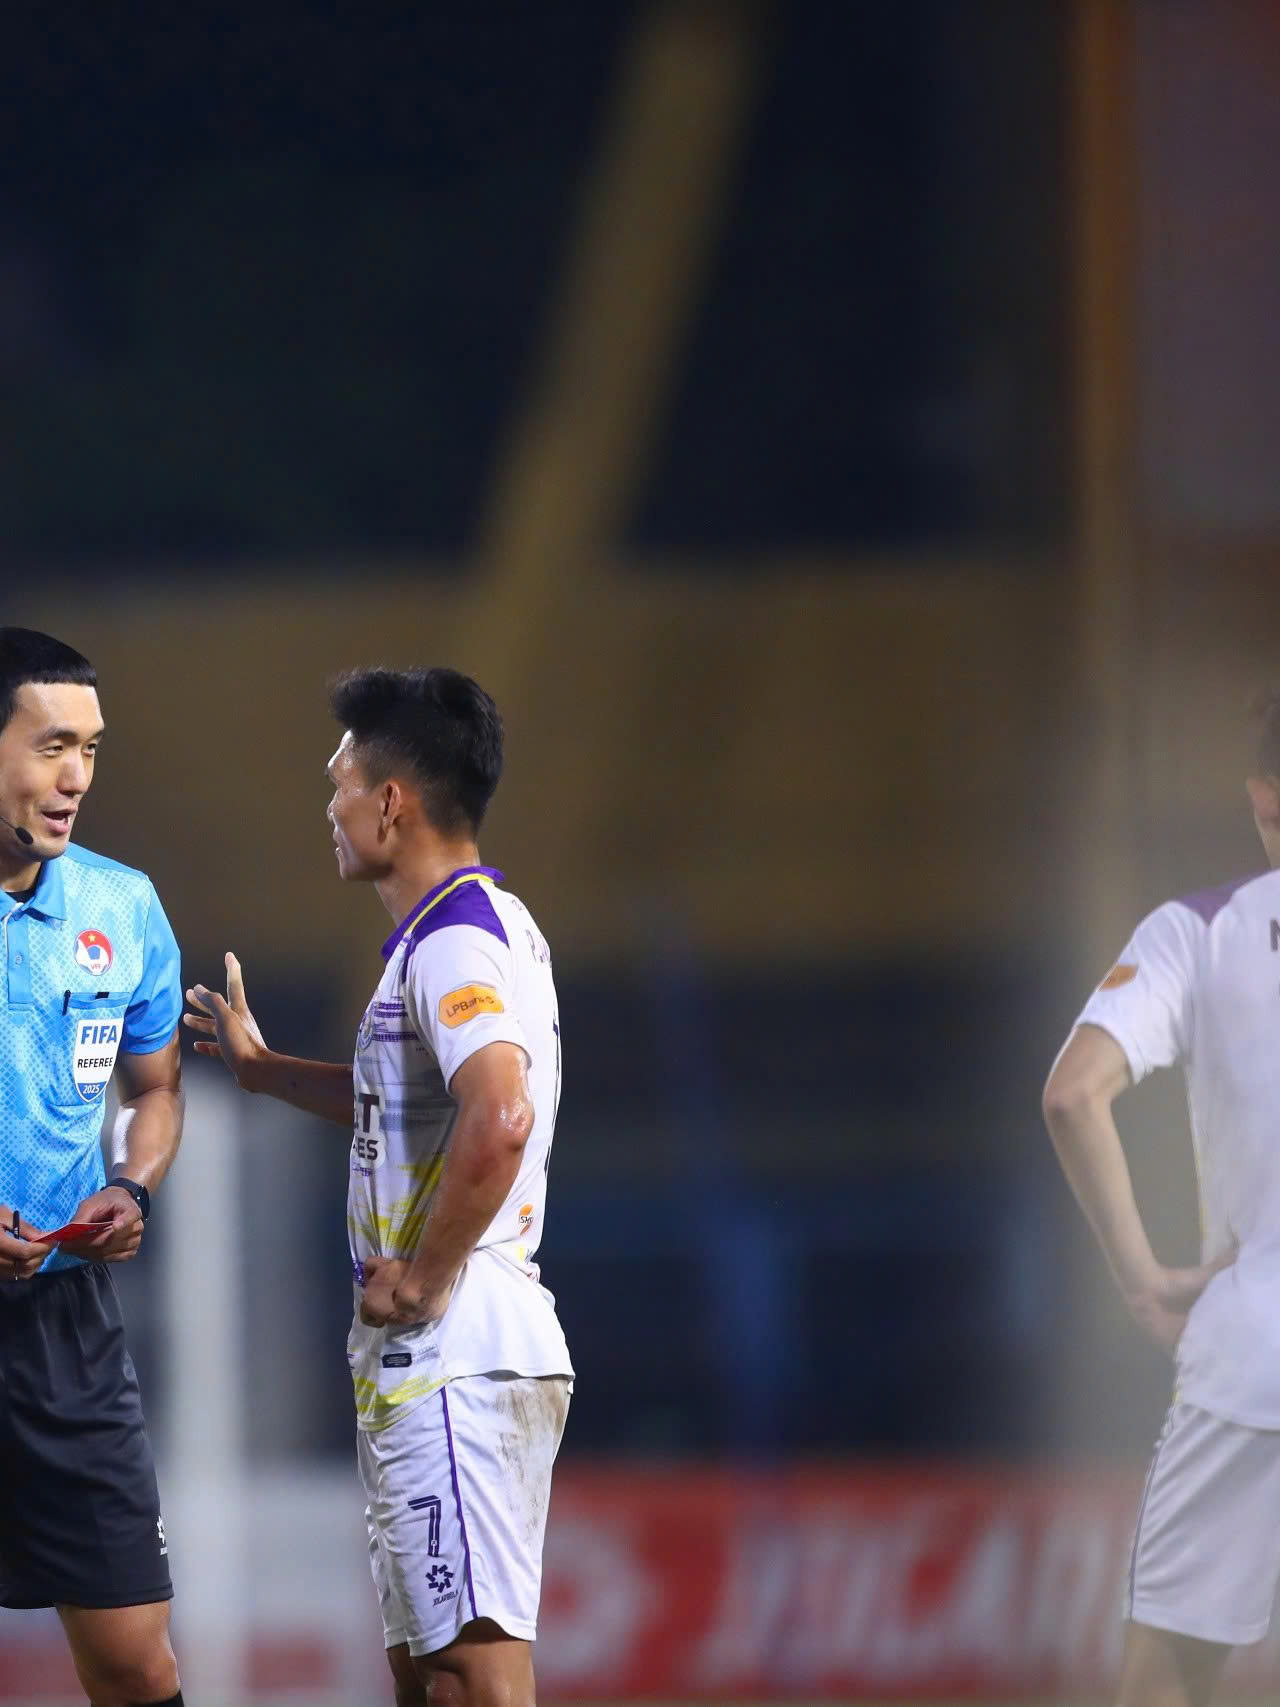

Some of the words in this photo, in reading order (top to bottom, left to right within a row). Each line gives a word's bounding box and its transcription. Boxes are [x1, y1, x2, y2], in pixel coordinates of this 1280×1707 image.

[80, 1024, 118, 1045] FIFA
[77, 1057, 113, 1069] REFEREE
[82, 1084, 100, 1094] 2025
[407, 1494, 442, 1558] 7
